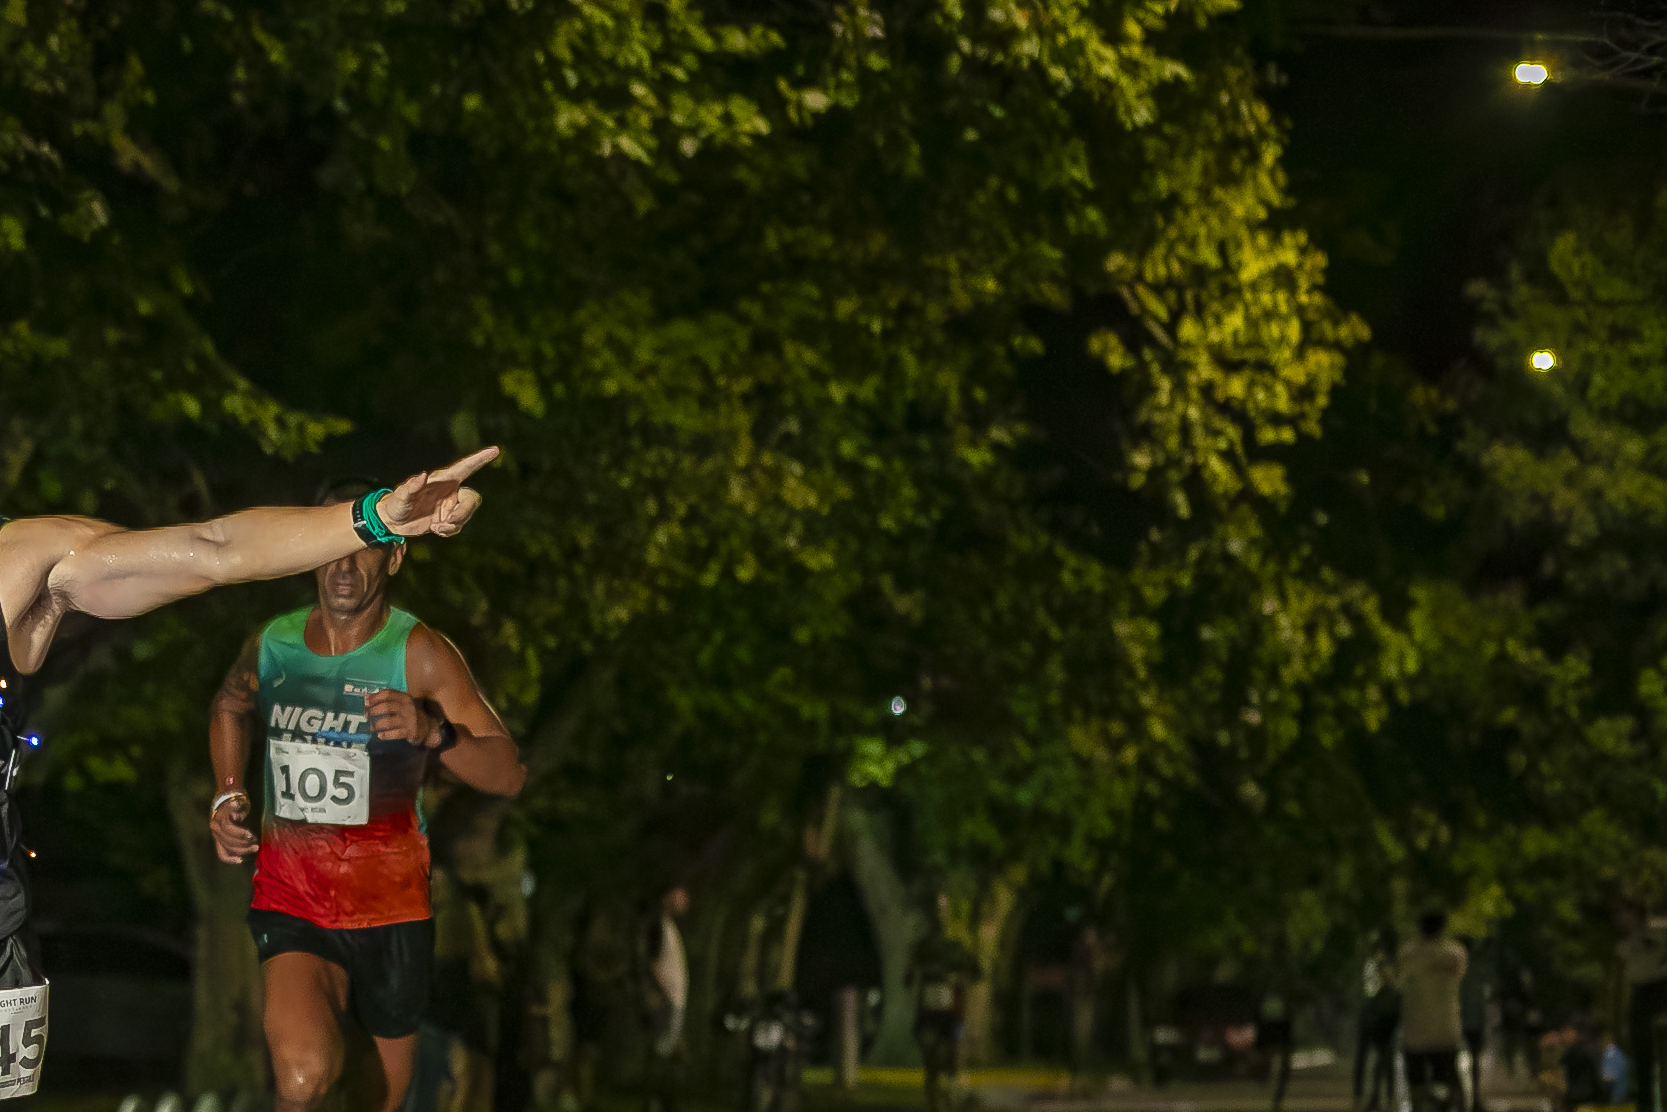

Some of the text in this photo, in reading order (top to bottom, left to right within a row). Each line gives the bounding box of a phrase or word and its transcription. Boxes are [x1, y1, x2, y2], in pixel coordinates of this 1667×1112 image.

[270, 703, 368, 734] NIGHT
[279, 765, 356, 806] 105
[19, 996, 37, 1006] RUN
